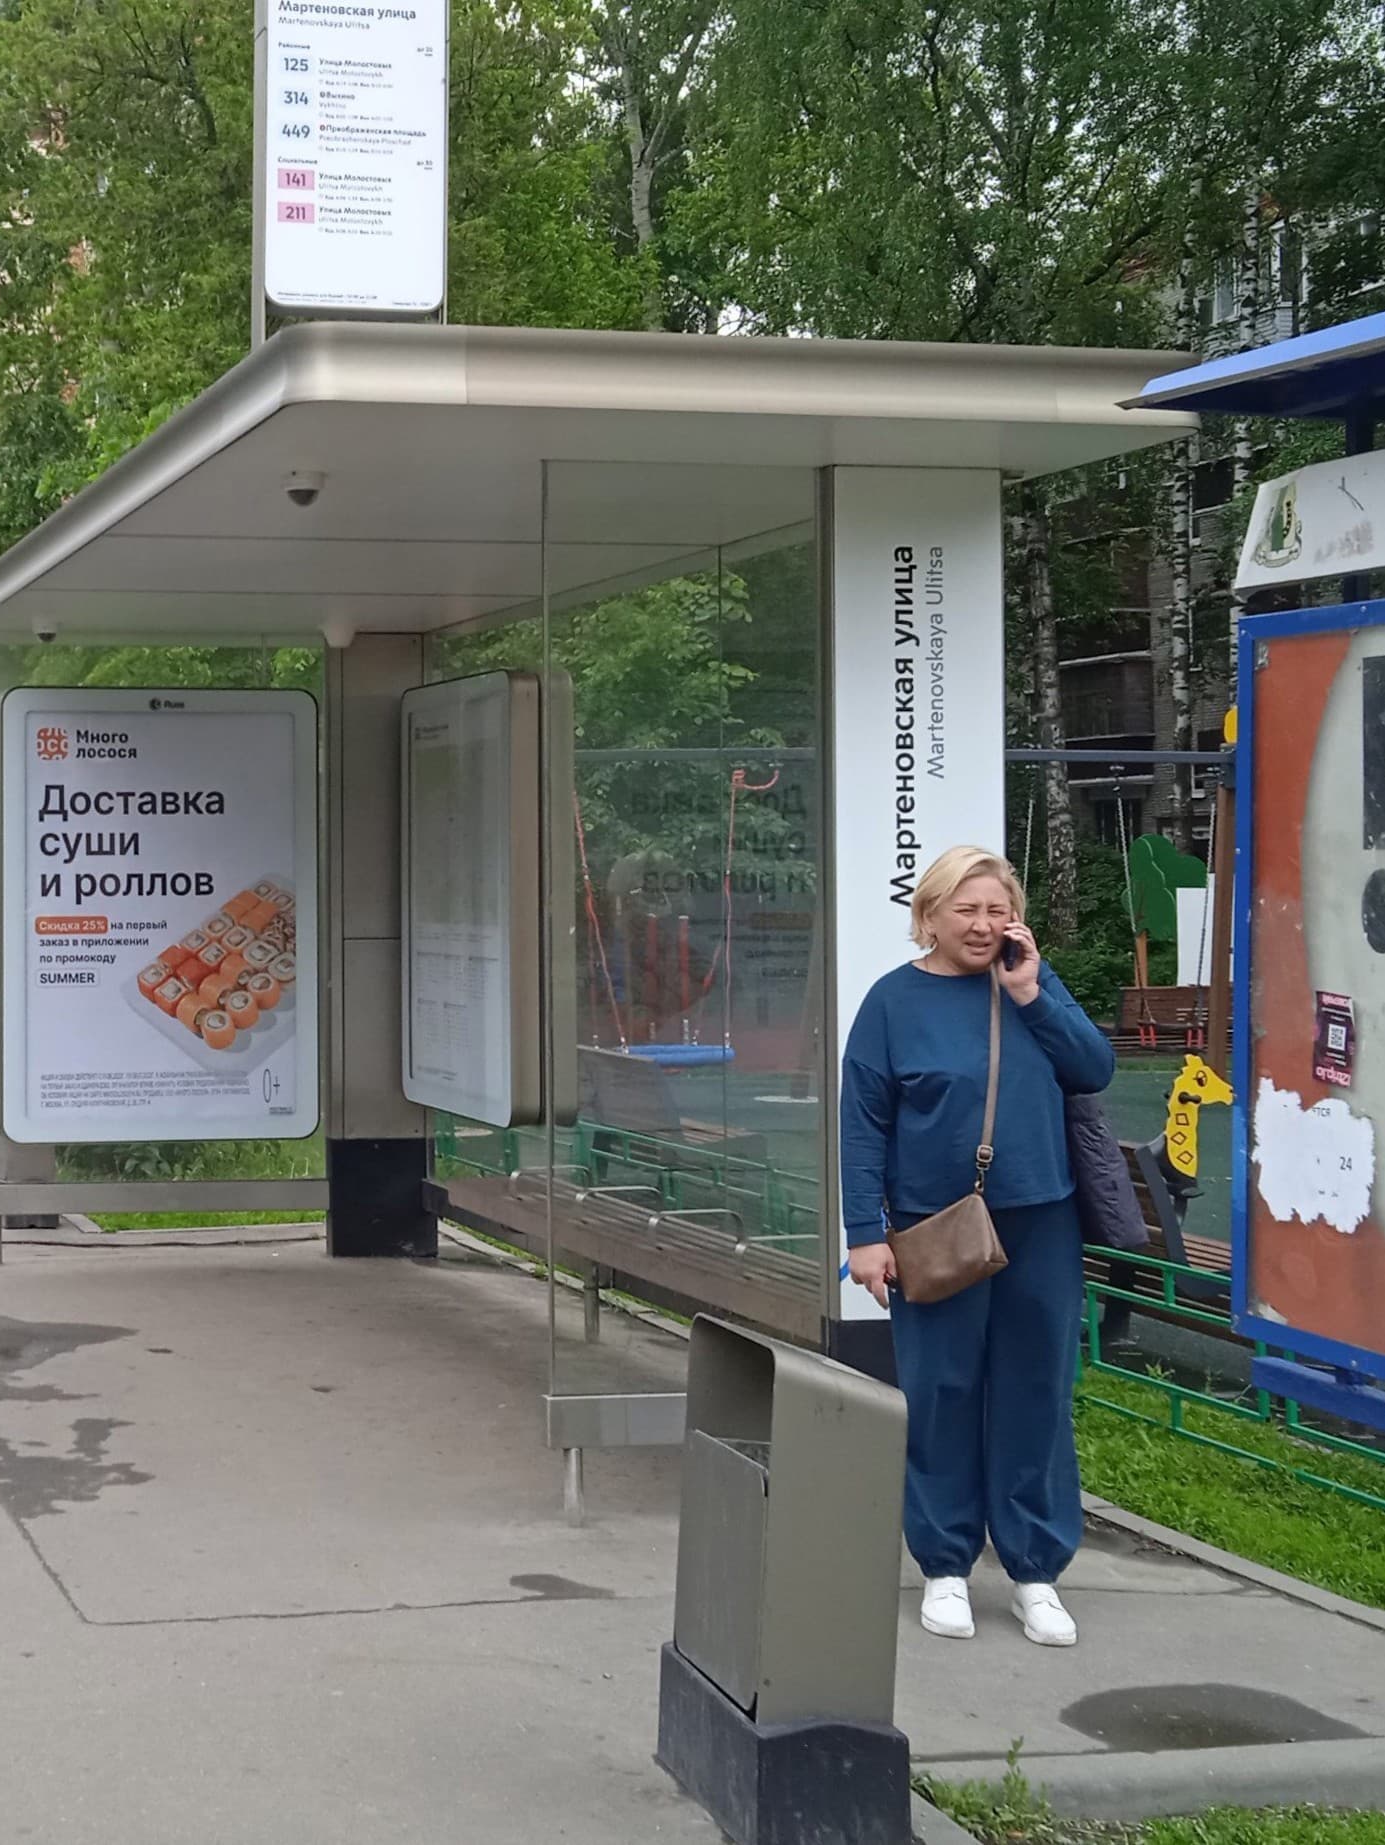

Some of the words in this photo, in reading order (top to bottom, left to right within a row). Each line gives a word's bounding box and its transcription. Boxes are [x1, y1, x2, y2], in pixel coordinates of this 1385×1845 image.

[278, 0, 374, 17] Мартеновская
[378, 8, 416, 21] улица
[278, 16, 343, 28] Martenovskaya
[283, 57, 309, 72] 125
[319, 58, 342, 67] Улица
[283, 90, 309, 105] 314
[282, 124, 310, 139] 449
[285, 172, 306, 187] 141
[319, 173, 342, 182] Улица
[285, 206, 306, 220] 211
[319, 206, 342, 215] Улица
[925, 546, 944, 605] Ulitsa
[893, 545, 920, 648] улица
[925, 613, 947, 780] Martenovskaya
[76, 730, 129, 744] Много
[76, 748, 138, 759] лосося
[890, 657, 921, 907] Мартеновская
[39, 784, 225, 822] Доставка
[40, 832, 140, 864] суши
[40, 873, 61, 897] и
[75, 872, 214, 905] роллов
[39, 921, 80, 932] Скидка
[82, 920, 105, 931] 25%
[110, 922, 124, 930] на
[126, 920, 168, 931] первый
[39, 939, 70, 947] заказ
[81, 938, 149, 948] приложении
[39, 955, 53, 963] по
[55, 954, 117, 964] промокоду
[39, 973, 95, 984] SUMMER
[1339, 1156, 1353, 1171] 24
